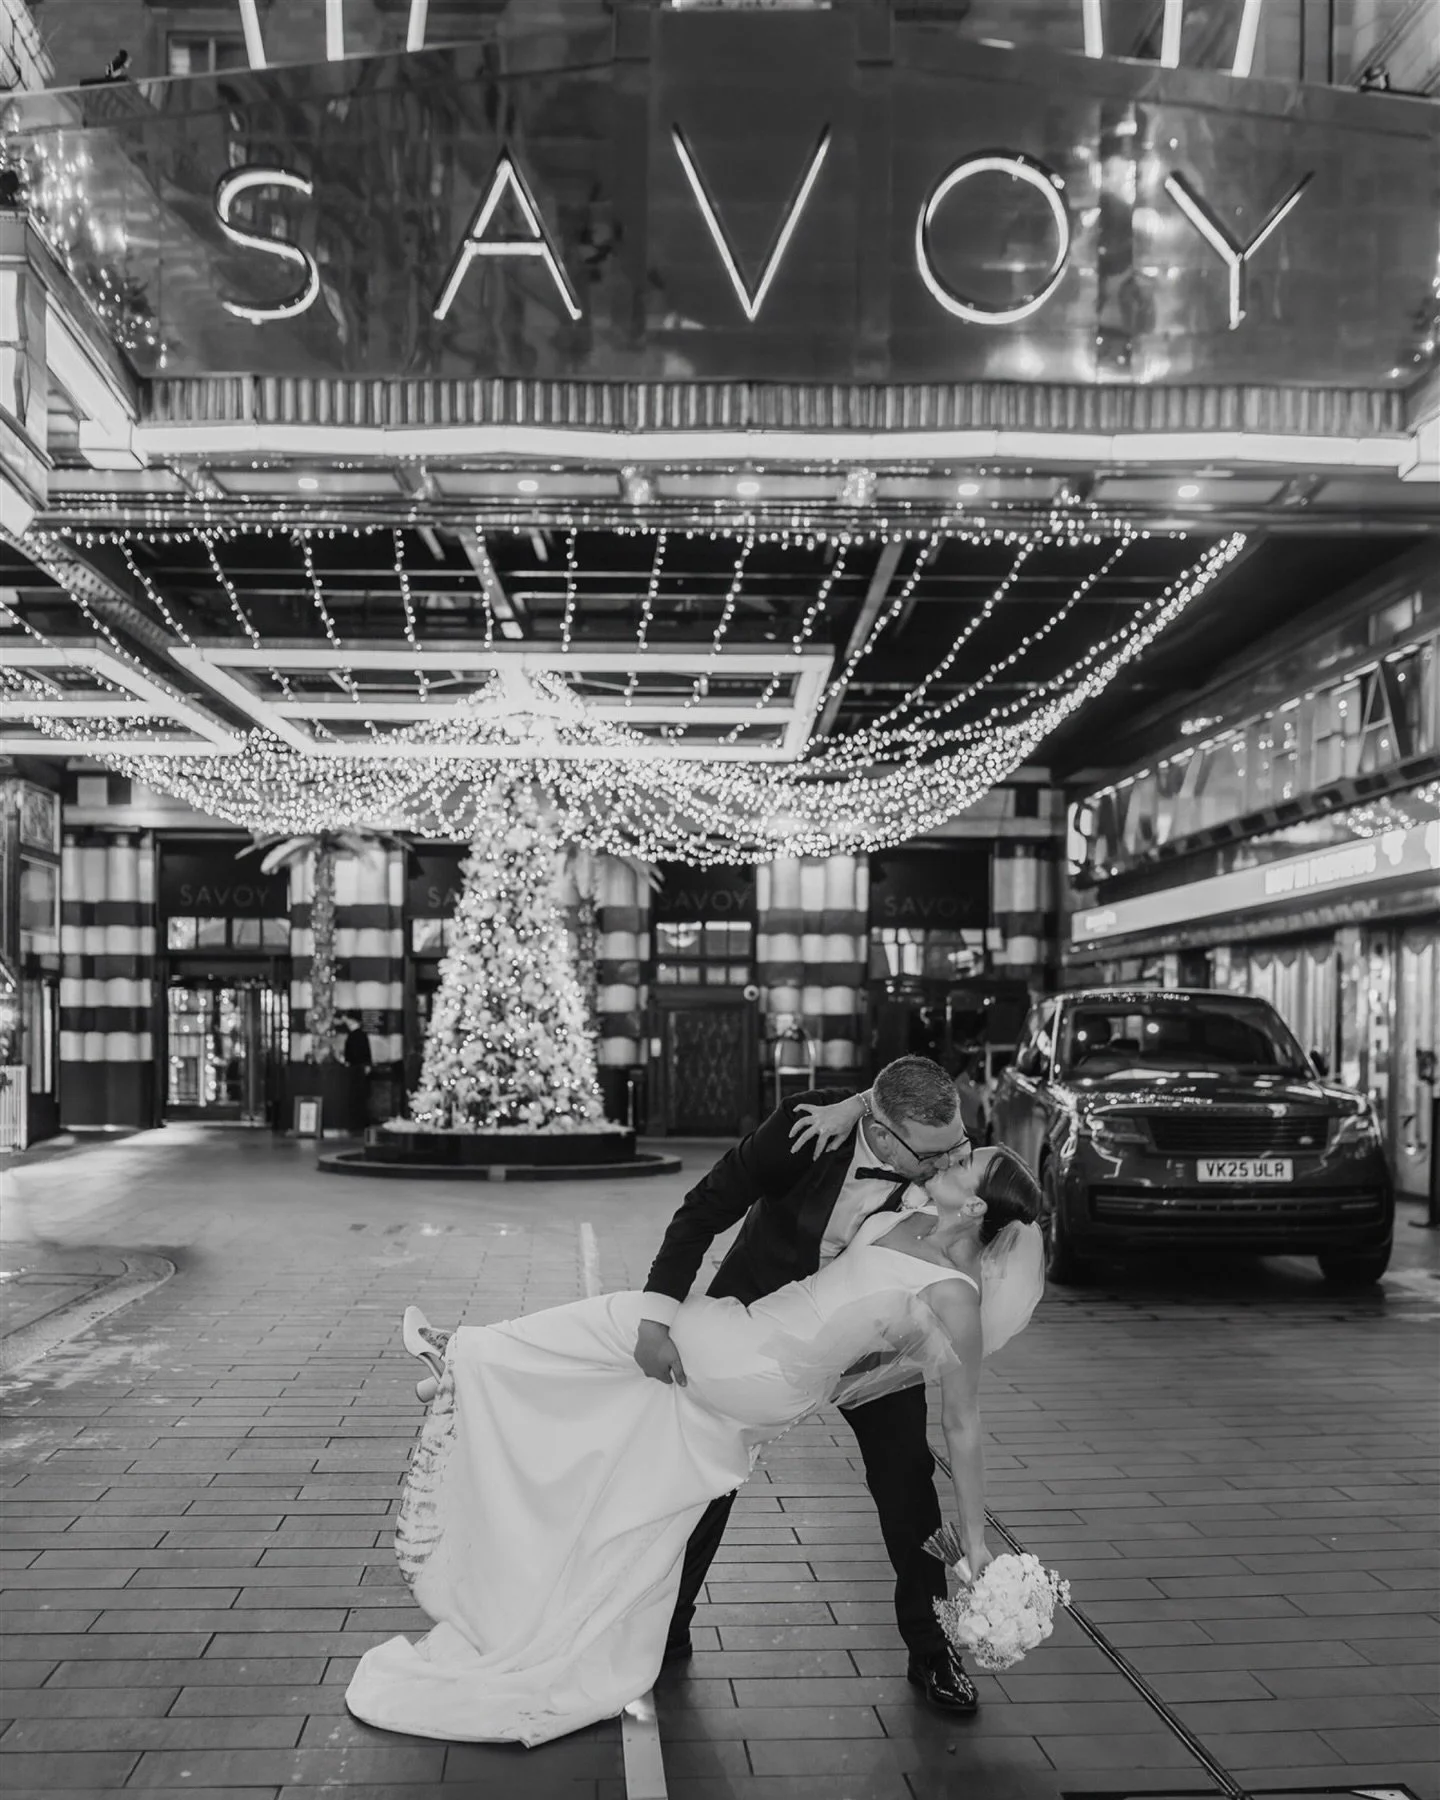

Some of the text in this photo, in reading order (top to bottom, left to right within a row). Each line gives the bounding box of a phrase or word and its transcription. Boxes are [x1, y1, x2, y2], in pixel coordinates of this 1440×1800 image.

[216, 124, 1313, 329] SAVOY
[180, 884, 270, 907] SAVOY
[884, 894, 974, 918] SAVOY
[1206, 1162, 1248, 1177] VK25
